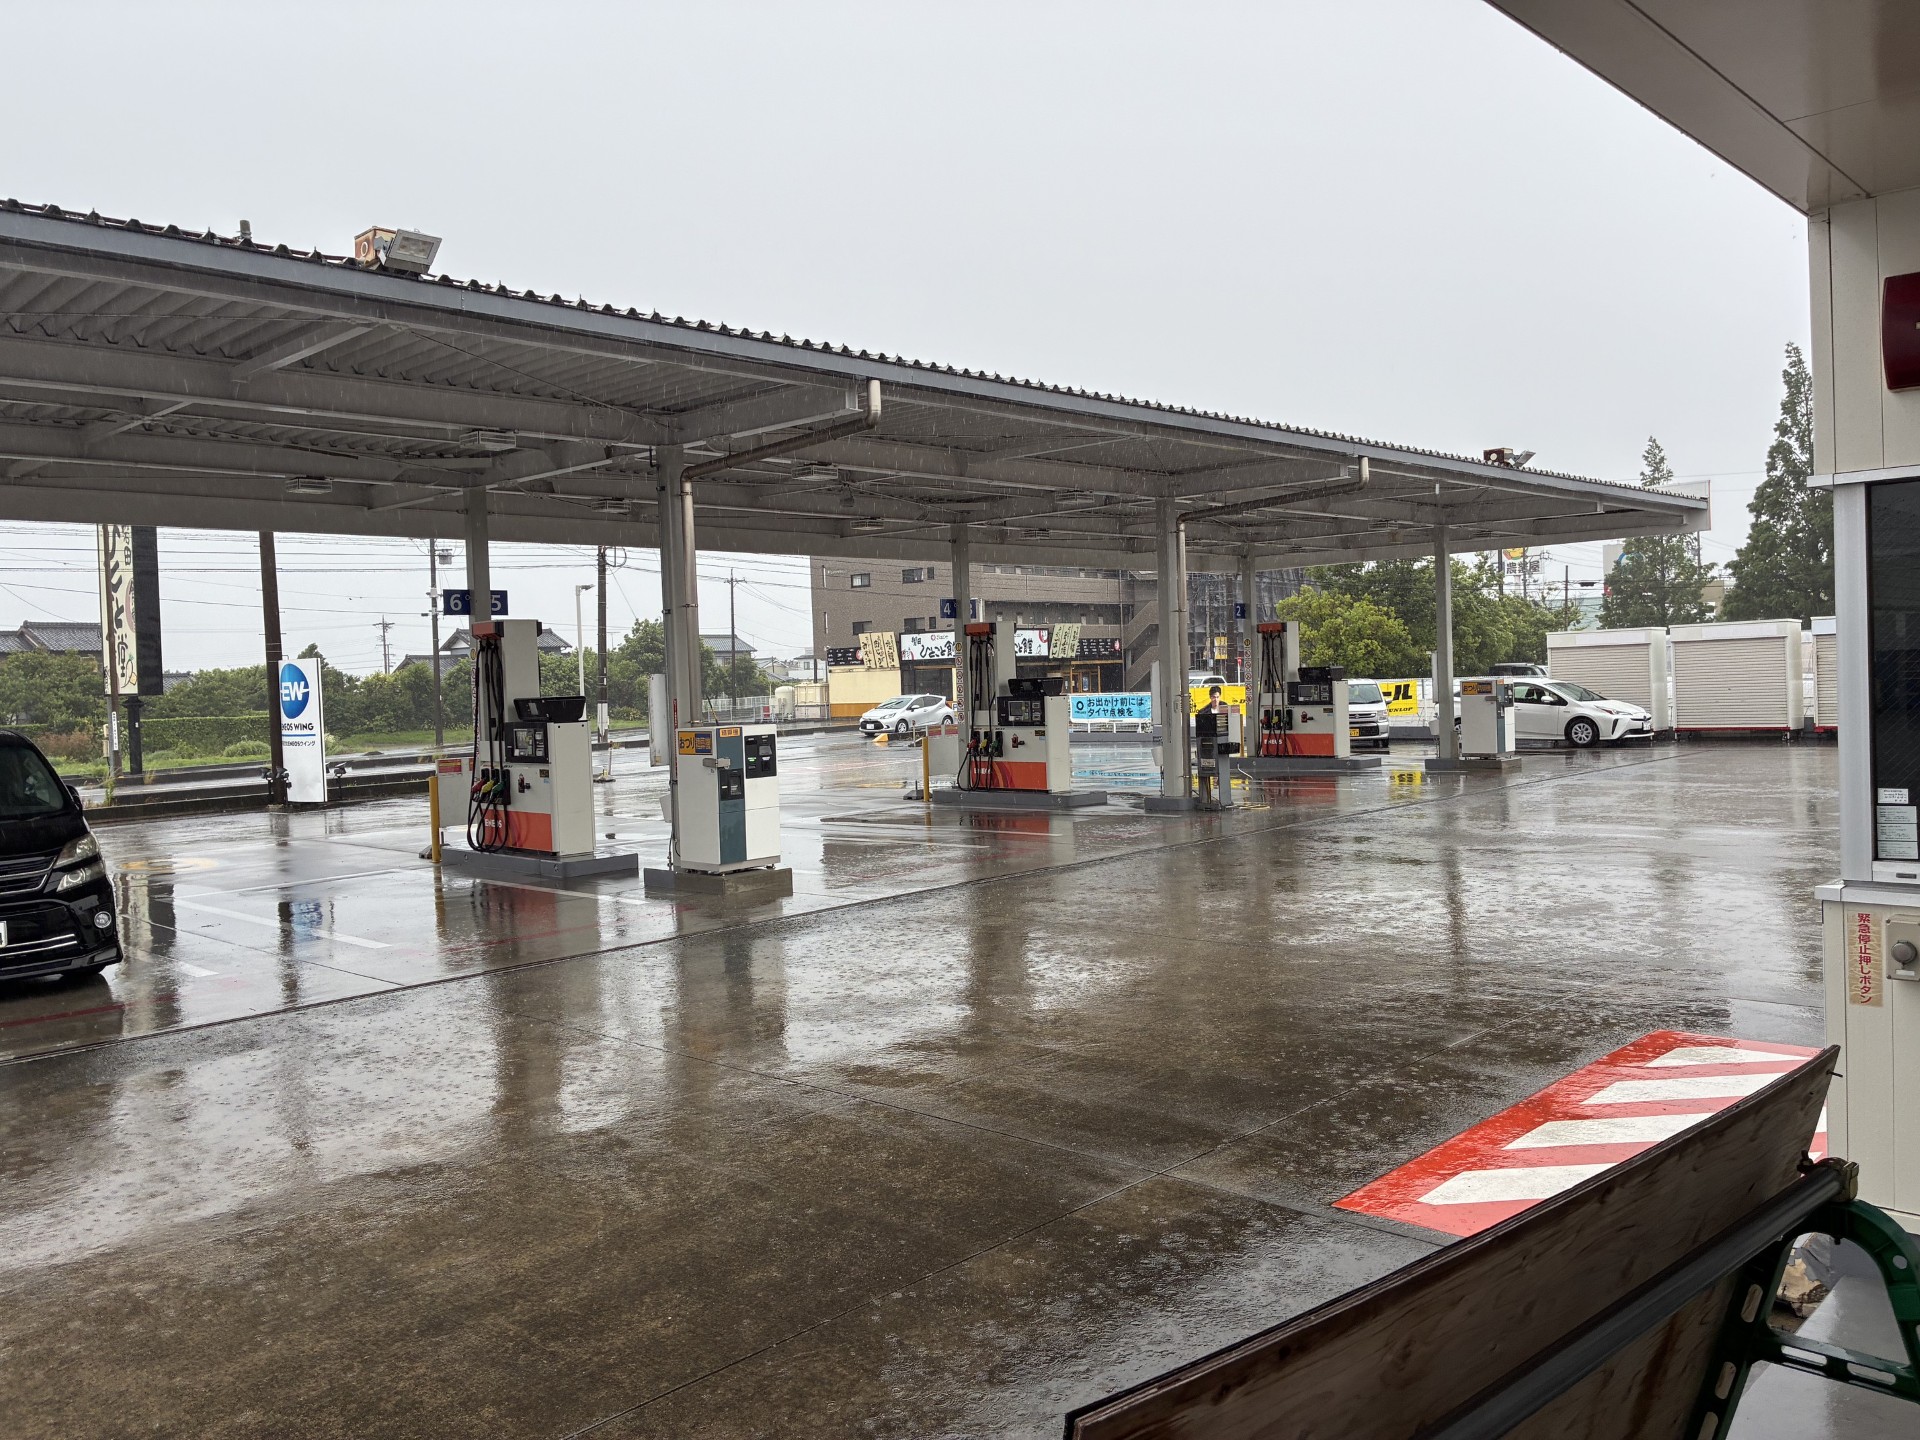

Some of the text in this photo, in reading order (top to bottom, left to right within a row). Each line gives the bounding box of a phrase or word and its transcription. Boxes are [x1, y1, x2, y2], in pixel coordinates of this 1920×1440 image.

[449, 593, 462, 611] 6
[490, 594, 502, 612] 5
[943, 602, 951, 615] 4
[1236, 605, 1242, 617] 2
[281, 681, 309, 702] EW
[1087, 697, 1145, 707] お出かけ前には
[1087, 707, 1134, 717] タイヤ点検を
[293, 722, 314, 731] WING
[679, 737, 695, 749] おつり
[484, 818, 503, 829] ENES
[1857, 912, 1872, 1004] 緊急停止押しボタン
